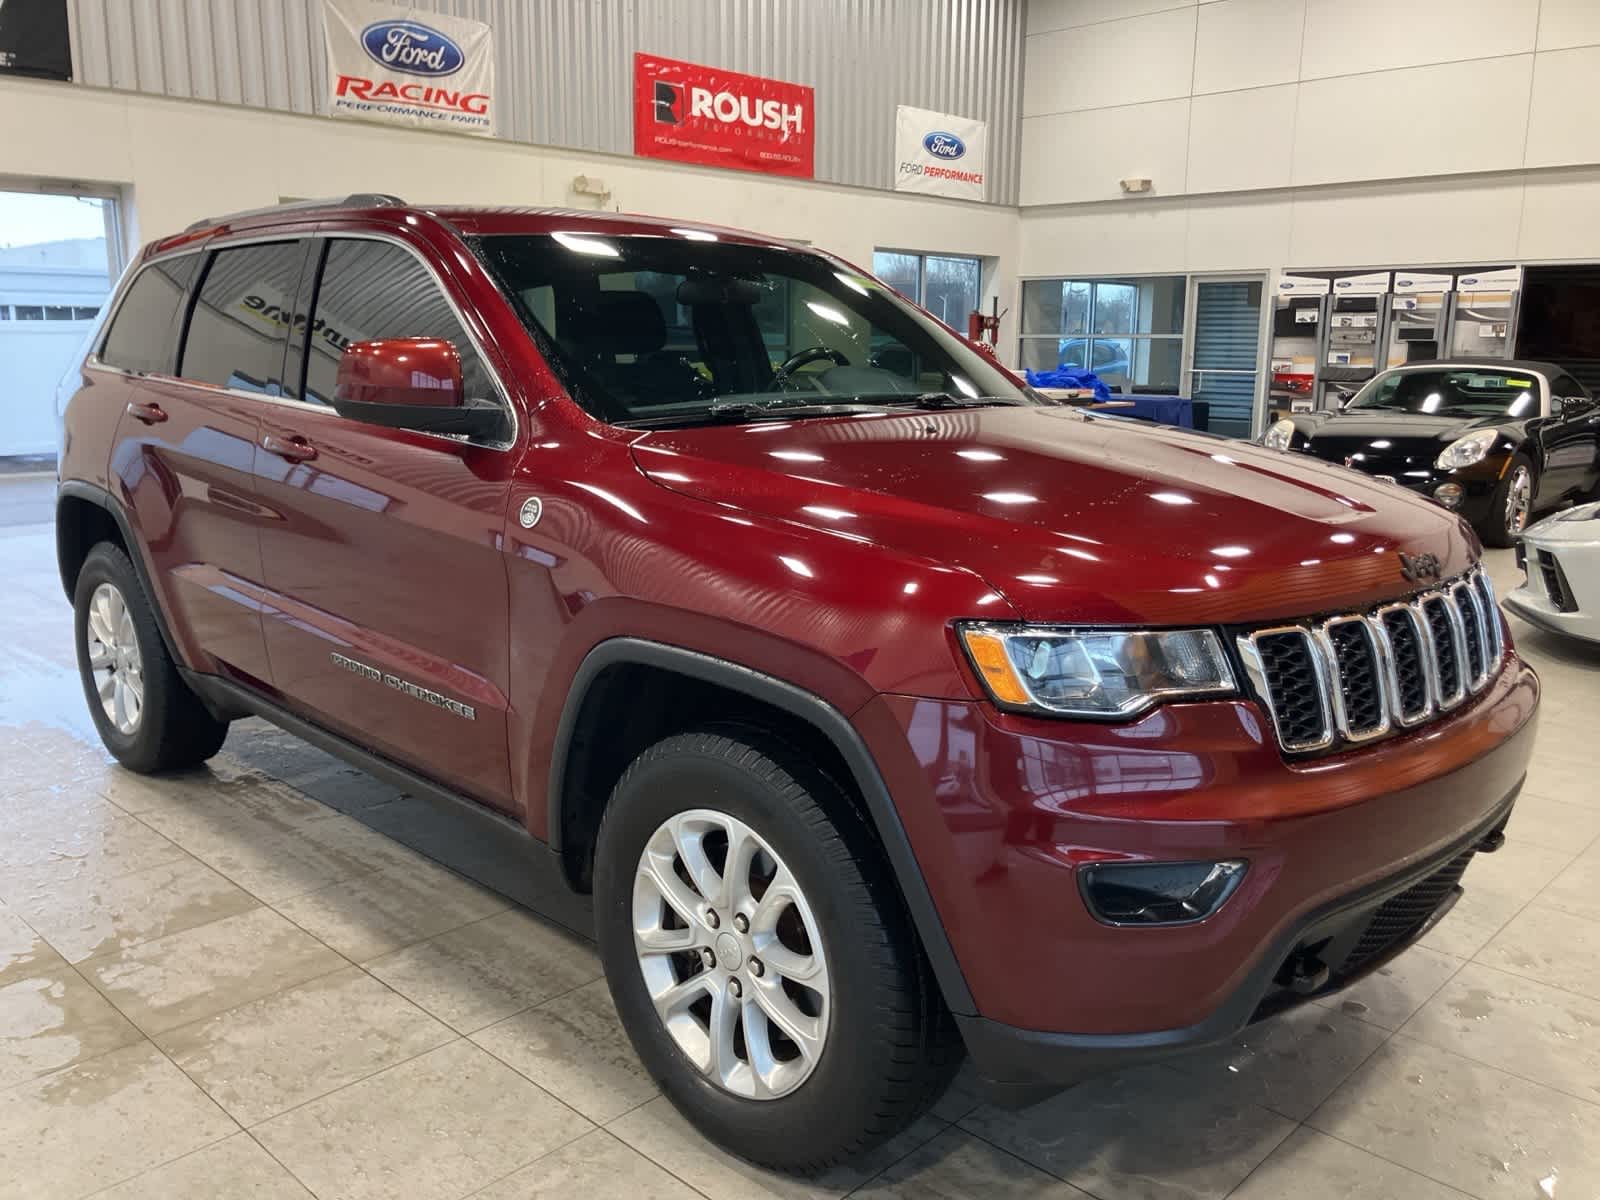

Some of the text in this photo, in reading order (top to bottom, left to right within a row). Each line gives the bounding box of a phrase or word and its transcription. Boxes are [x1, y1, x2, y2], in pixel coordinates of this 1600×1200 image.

[381, 28, 447, 70] Ford
[336, 74, 490, 115] RACING
[336, 99, 490, 126] PERFORMANCE PARTS
[691, 86, 803, 134] ROUSH
[930, 135, 959, 157] Ford
[900, 162, 984, 184] FORD PERFORMANCE
[384, 673, 477, 721] CHEROKEE
